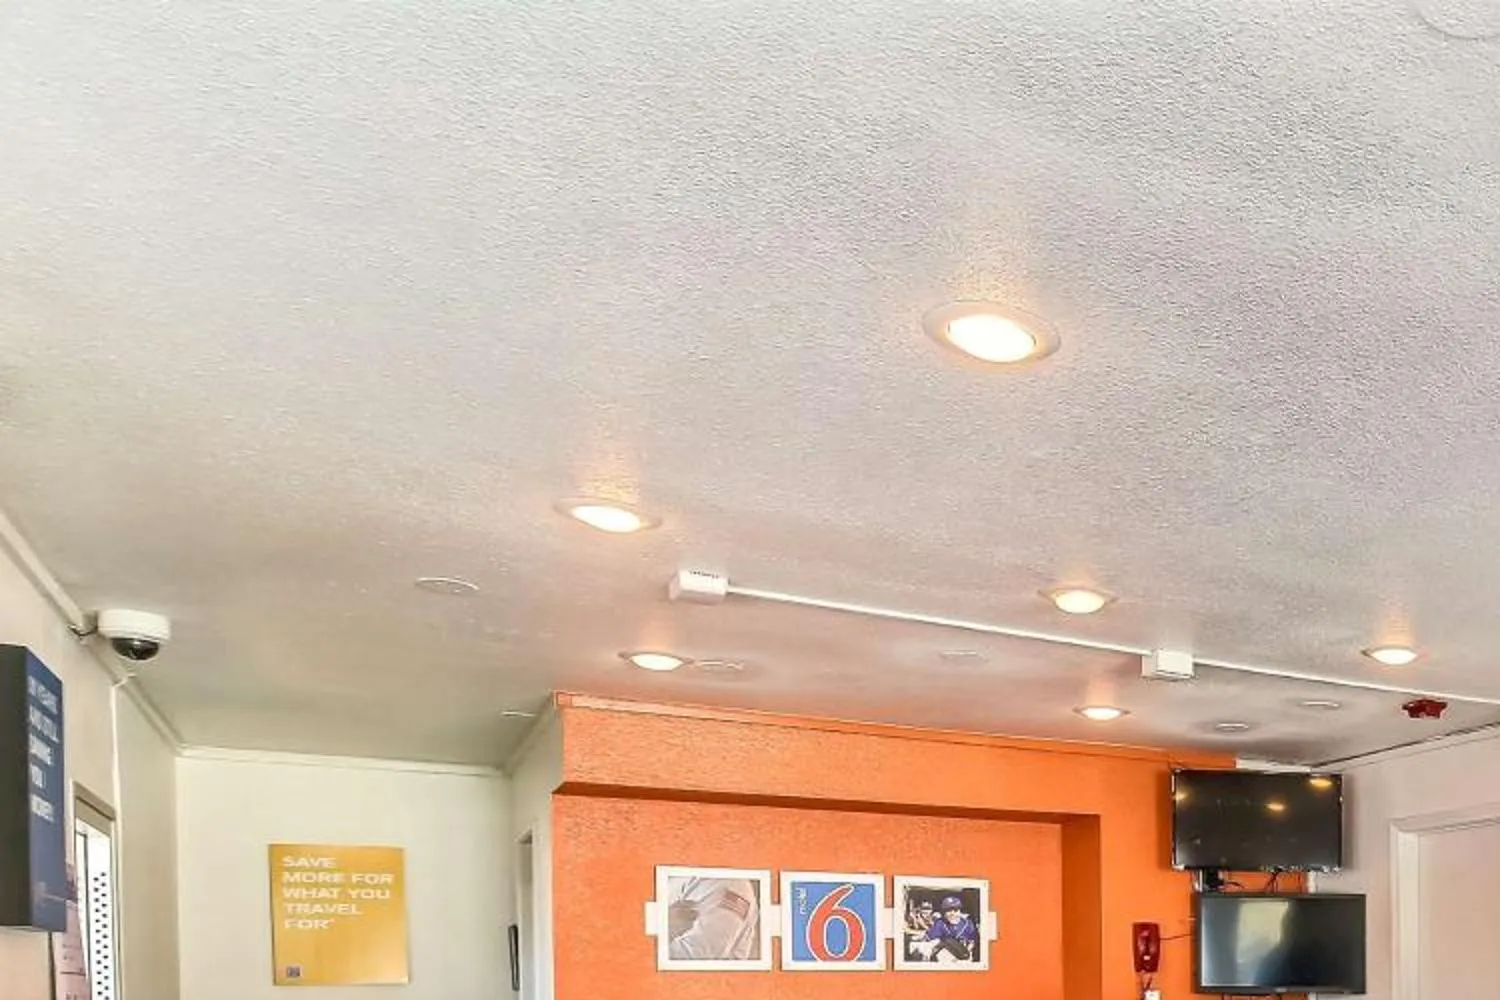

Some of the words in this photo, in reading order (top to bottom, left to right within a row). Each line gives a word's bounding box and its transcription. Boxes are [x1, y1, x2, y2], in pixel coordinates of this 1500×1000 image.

[282, 856, 337, 868] SAVE
[283, 871, 344, 883] MORE
[351, 873, 394, 884] FOR
[283, 887, 341, 899] WHAT
[348, 888, 390, 900] YOU
[285, 903, 364, 916] TRAVEL
[806, 883, 866, 961] 6
